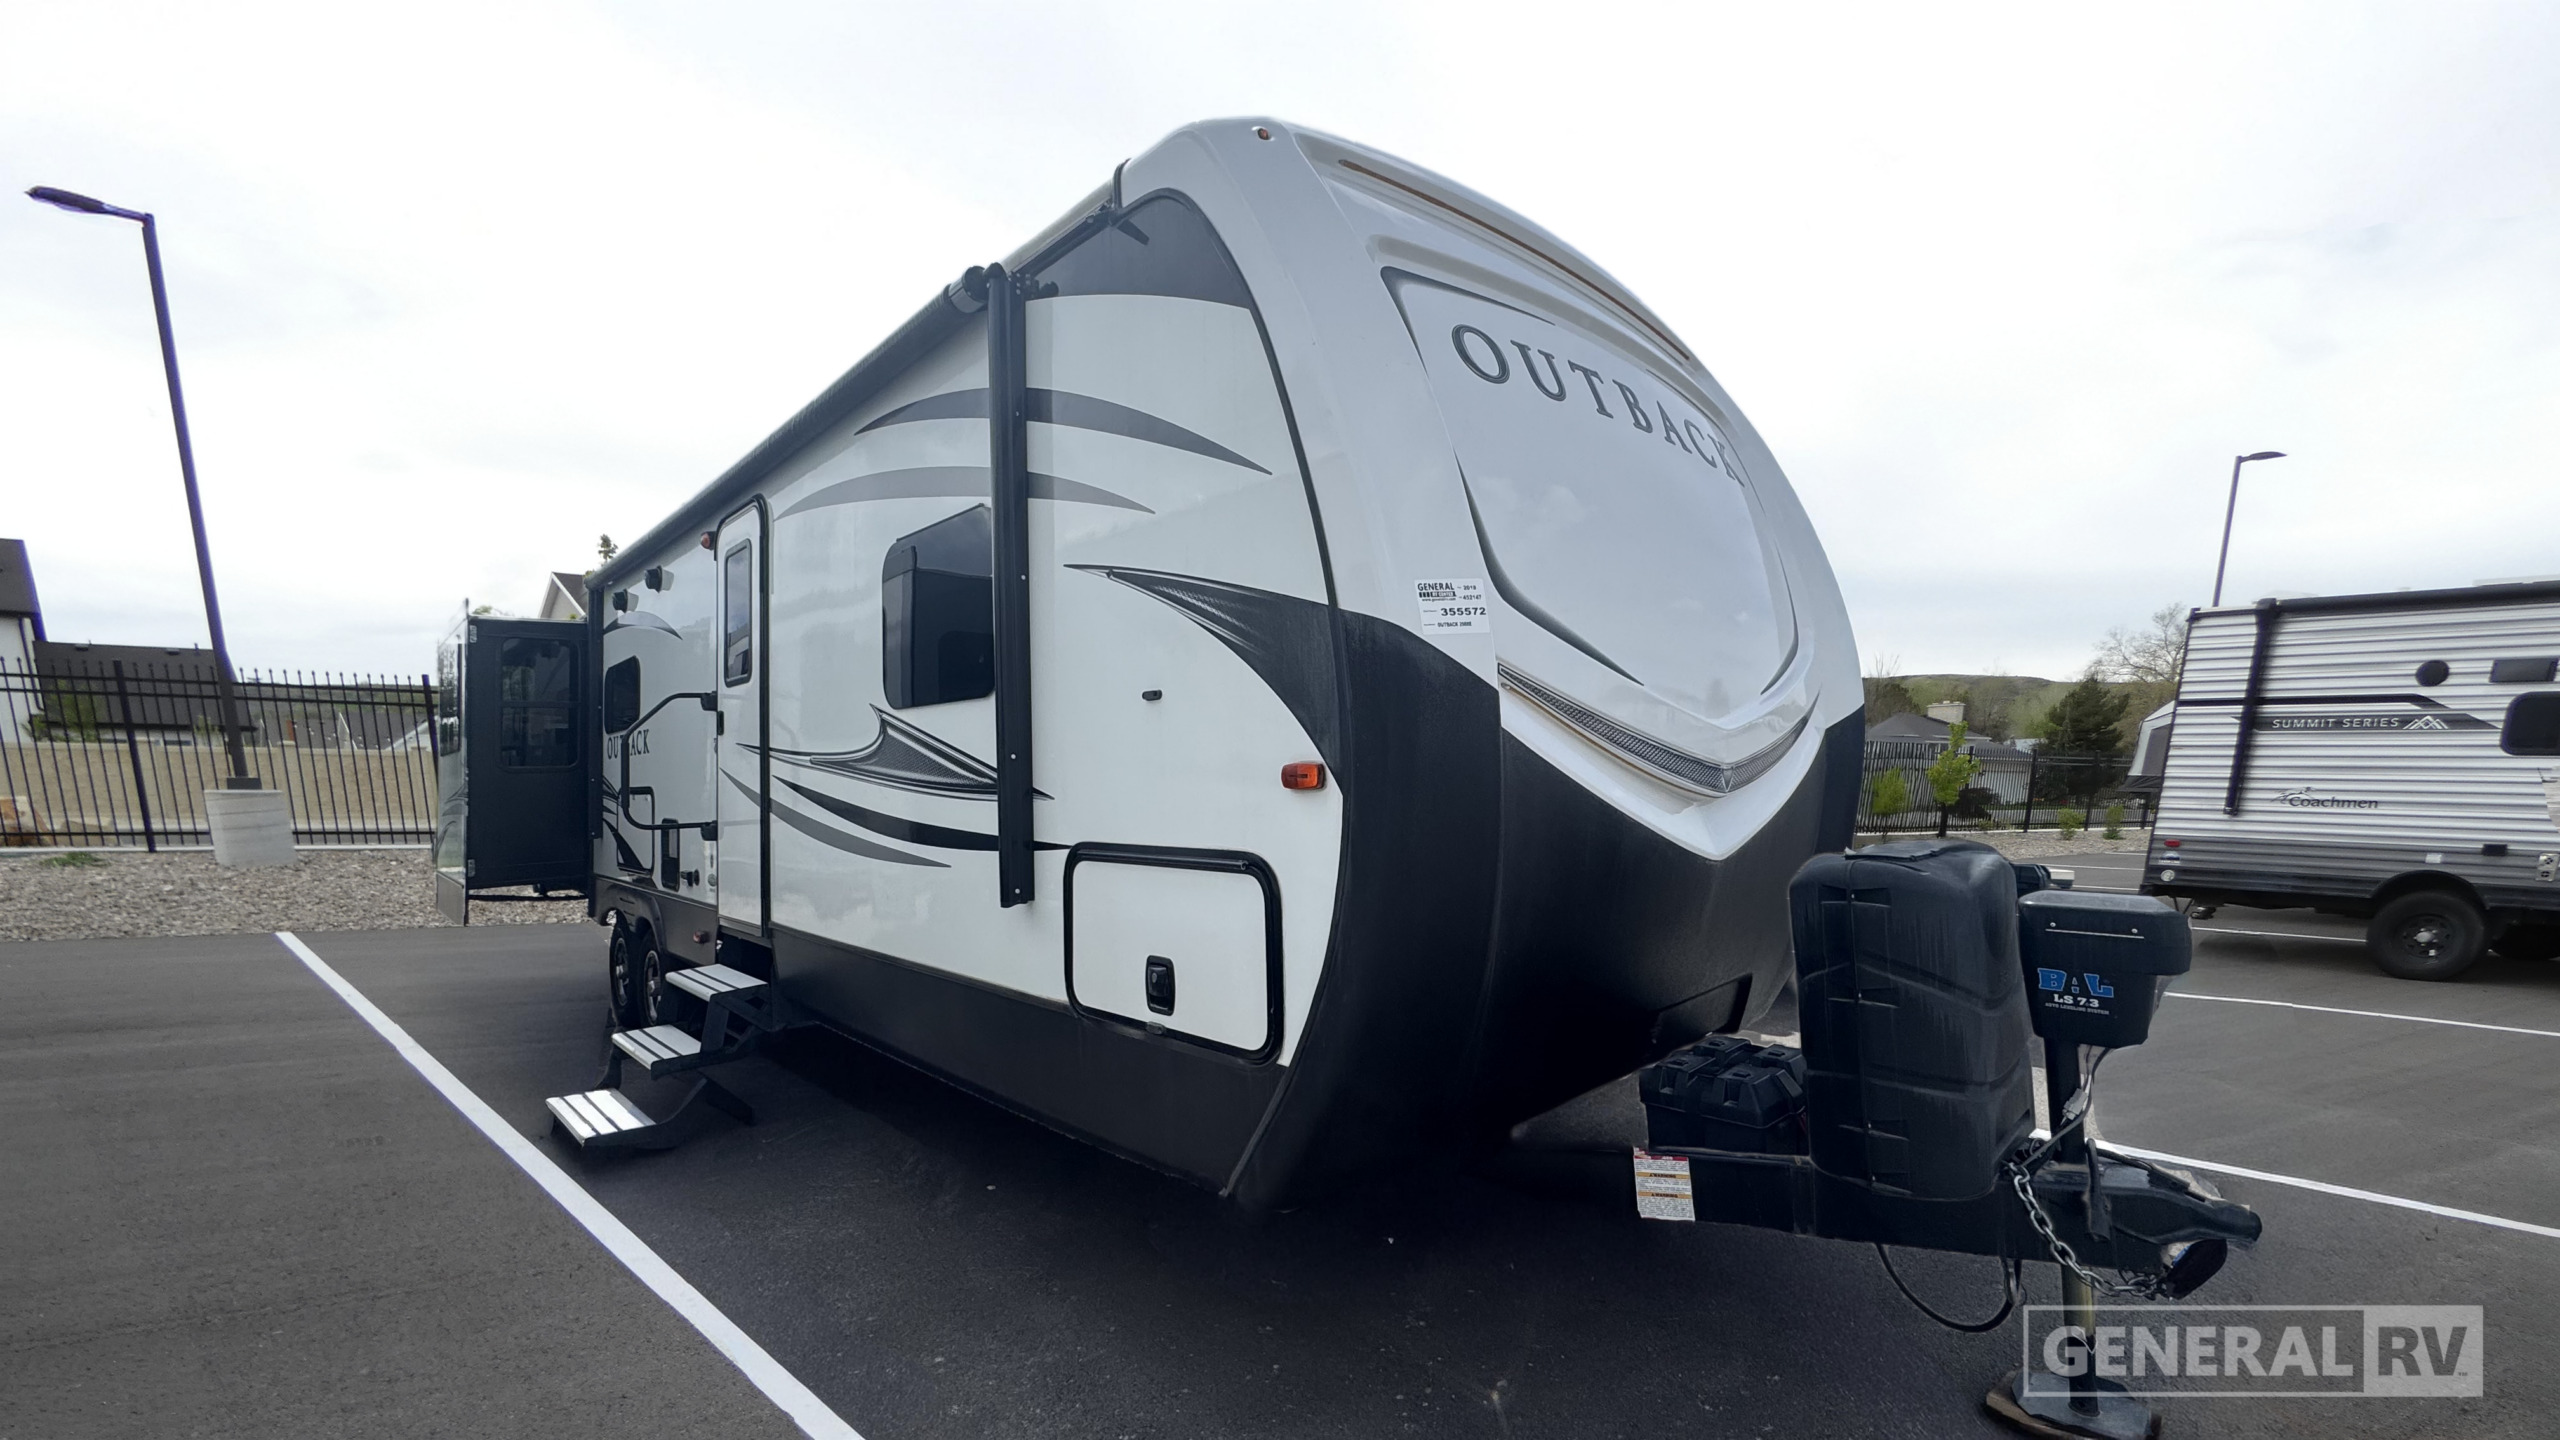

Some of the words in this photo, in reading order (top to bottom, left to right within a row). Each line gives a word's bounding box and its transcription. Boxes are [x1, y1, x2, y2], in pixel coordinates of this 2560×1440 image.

[1451, 323, 1746, 488] OUTBACK
[1417, 582, 1455, 591] GENERAL
[1440, 607, 1487, 616] 355572
[2272, 718, 2336, 729] SUMMIT
[2342, 717, 2399, 728] SERIES
[607, 729, 650, 760] OUACK
[2288, 796, 2379, 809] Coachmen
[2053, 993, 2074, 1005] LS
[2087, 1007, 2110, 1015] SYSTEM
